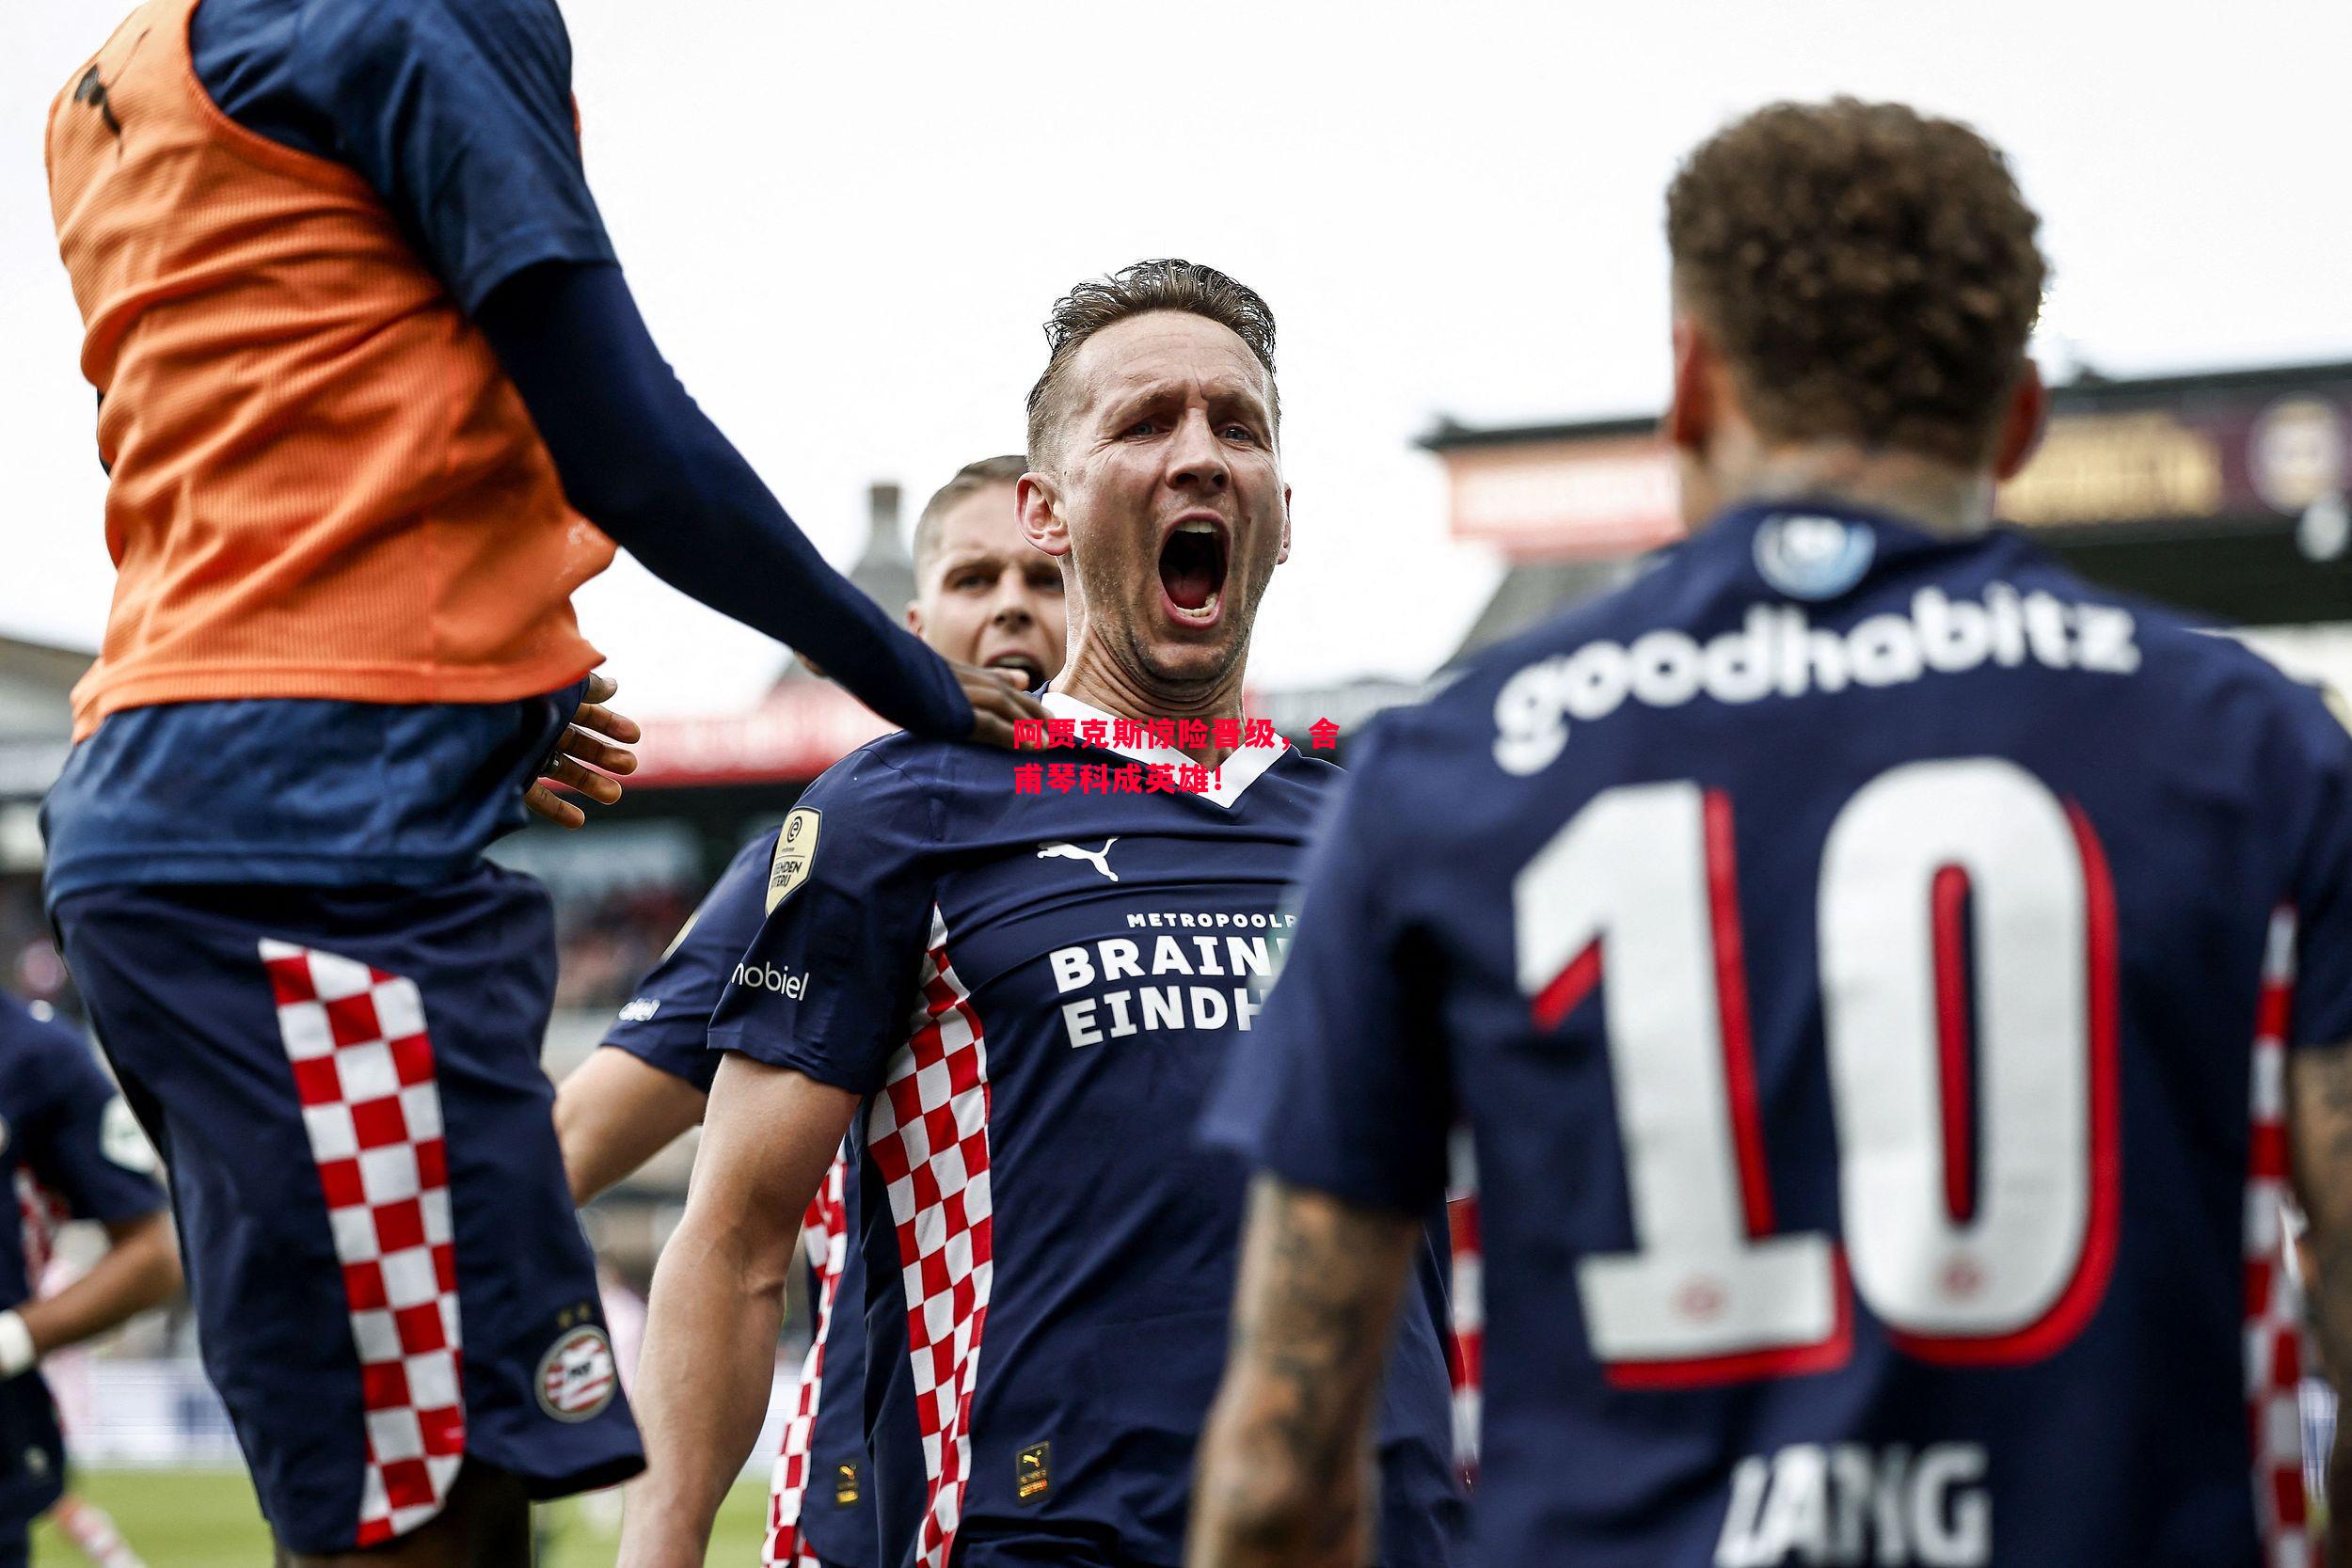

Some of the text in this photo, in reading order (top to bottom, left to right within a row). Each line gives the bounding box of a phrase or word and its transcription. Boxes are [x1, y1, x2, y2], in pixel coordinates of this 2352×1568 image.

[1493, 581, 2141, 778] goodhabitz
[1514, 757, 2120, 1389] 10
[1714, 1441, 1994, 1568] LANG
